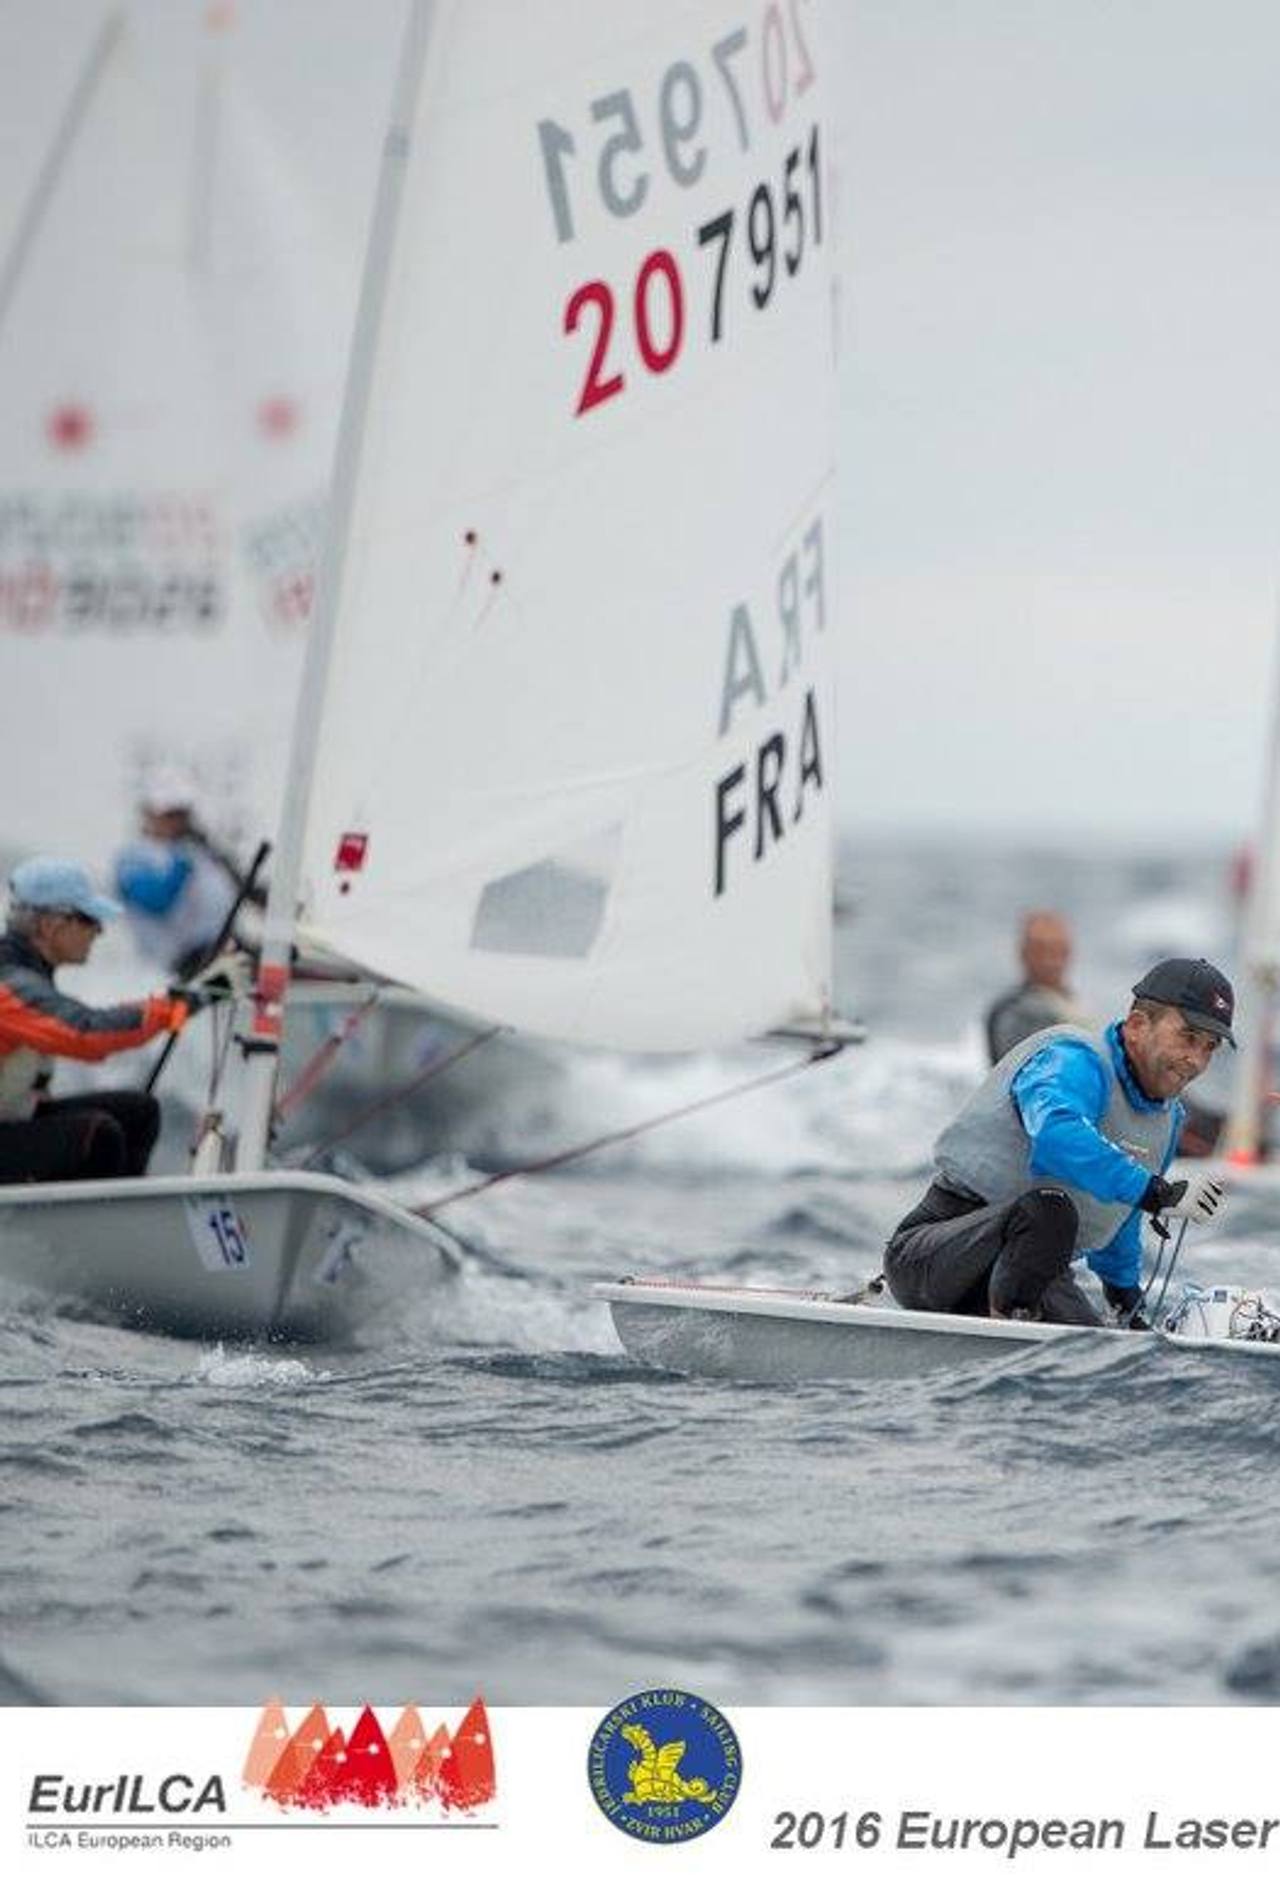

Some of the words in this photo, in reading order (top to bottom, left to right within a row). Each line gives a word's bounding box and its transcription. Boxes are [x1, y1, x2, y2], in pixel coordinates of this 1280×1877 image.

[564, 121, 823, 419] 207951
[713, 683, 823, 898] FRA
[210, 1209, 246, 1266] 15
